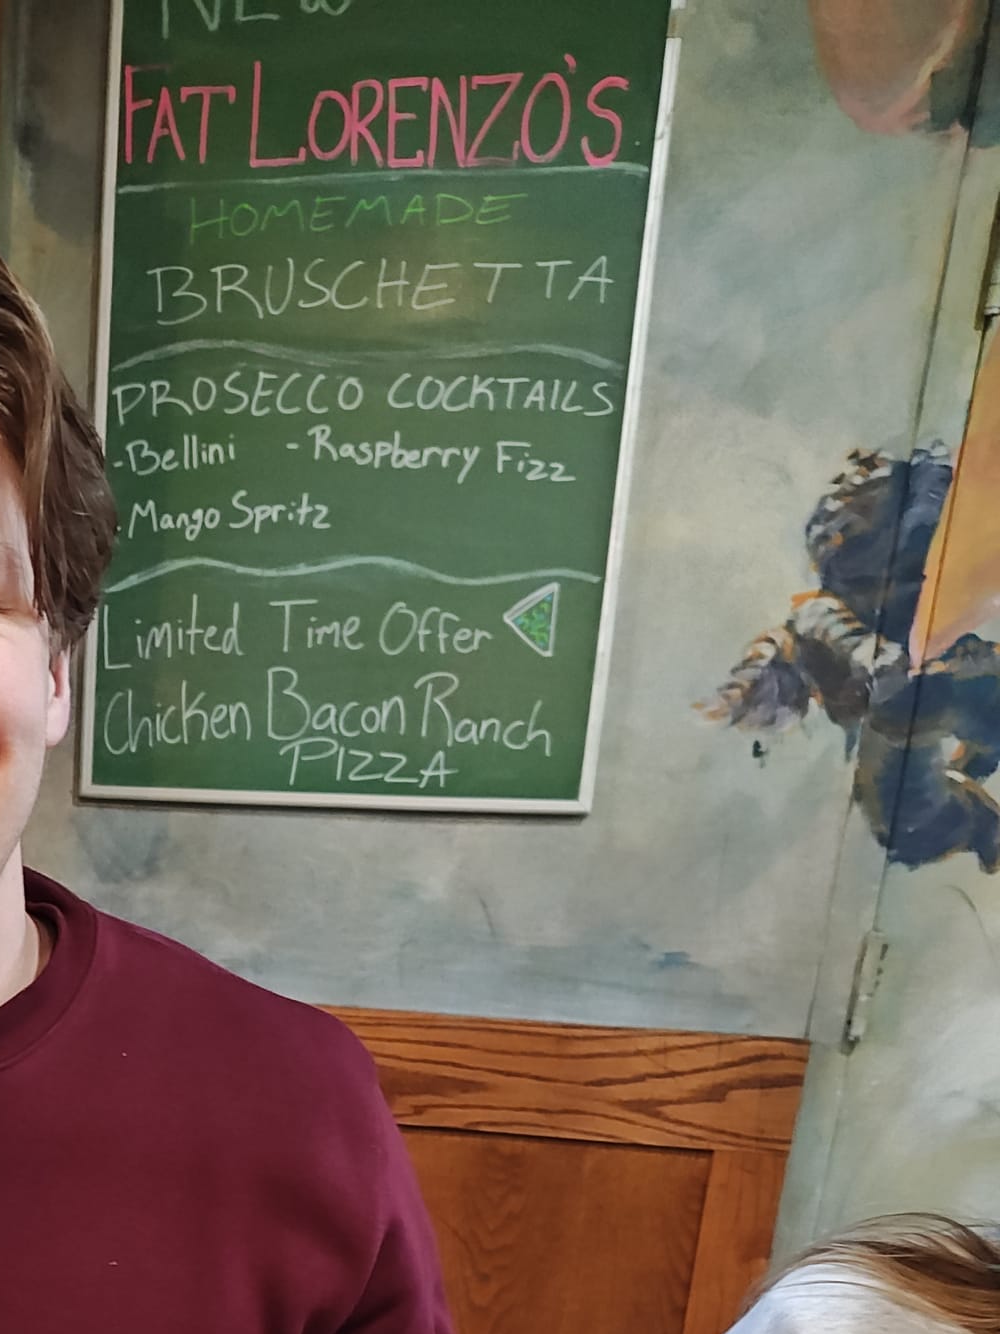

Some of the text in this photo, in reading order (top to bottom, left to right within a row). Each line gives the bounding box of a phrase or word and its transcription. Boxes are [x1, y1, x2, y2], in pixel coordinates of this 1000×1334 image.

[124, 54, 630, 168] FAT LORENZO'S
[189, 192, 529, 244] HOMEMADE
[147, 255, 615, 325] BRUSCHETTA
[111, 371, 616, 426] PROSECCO COCKTAILS
[496, 441, 577, 482] Fizz
[229, 490, 332, 533] Spritz
[103, 593, 494, 670] Limited Time Offer
[103, 666, 552, 757] Chicken Bacon Ranch
[279, 737, 459, 788] PIZZA
